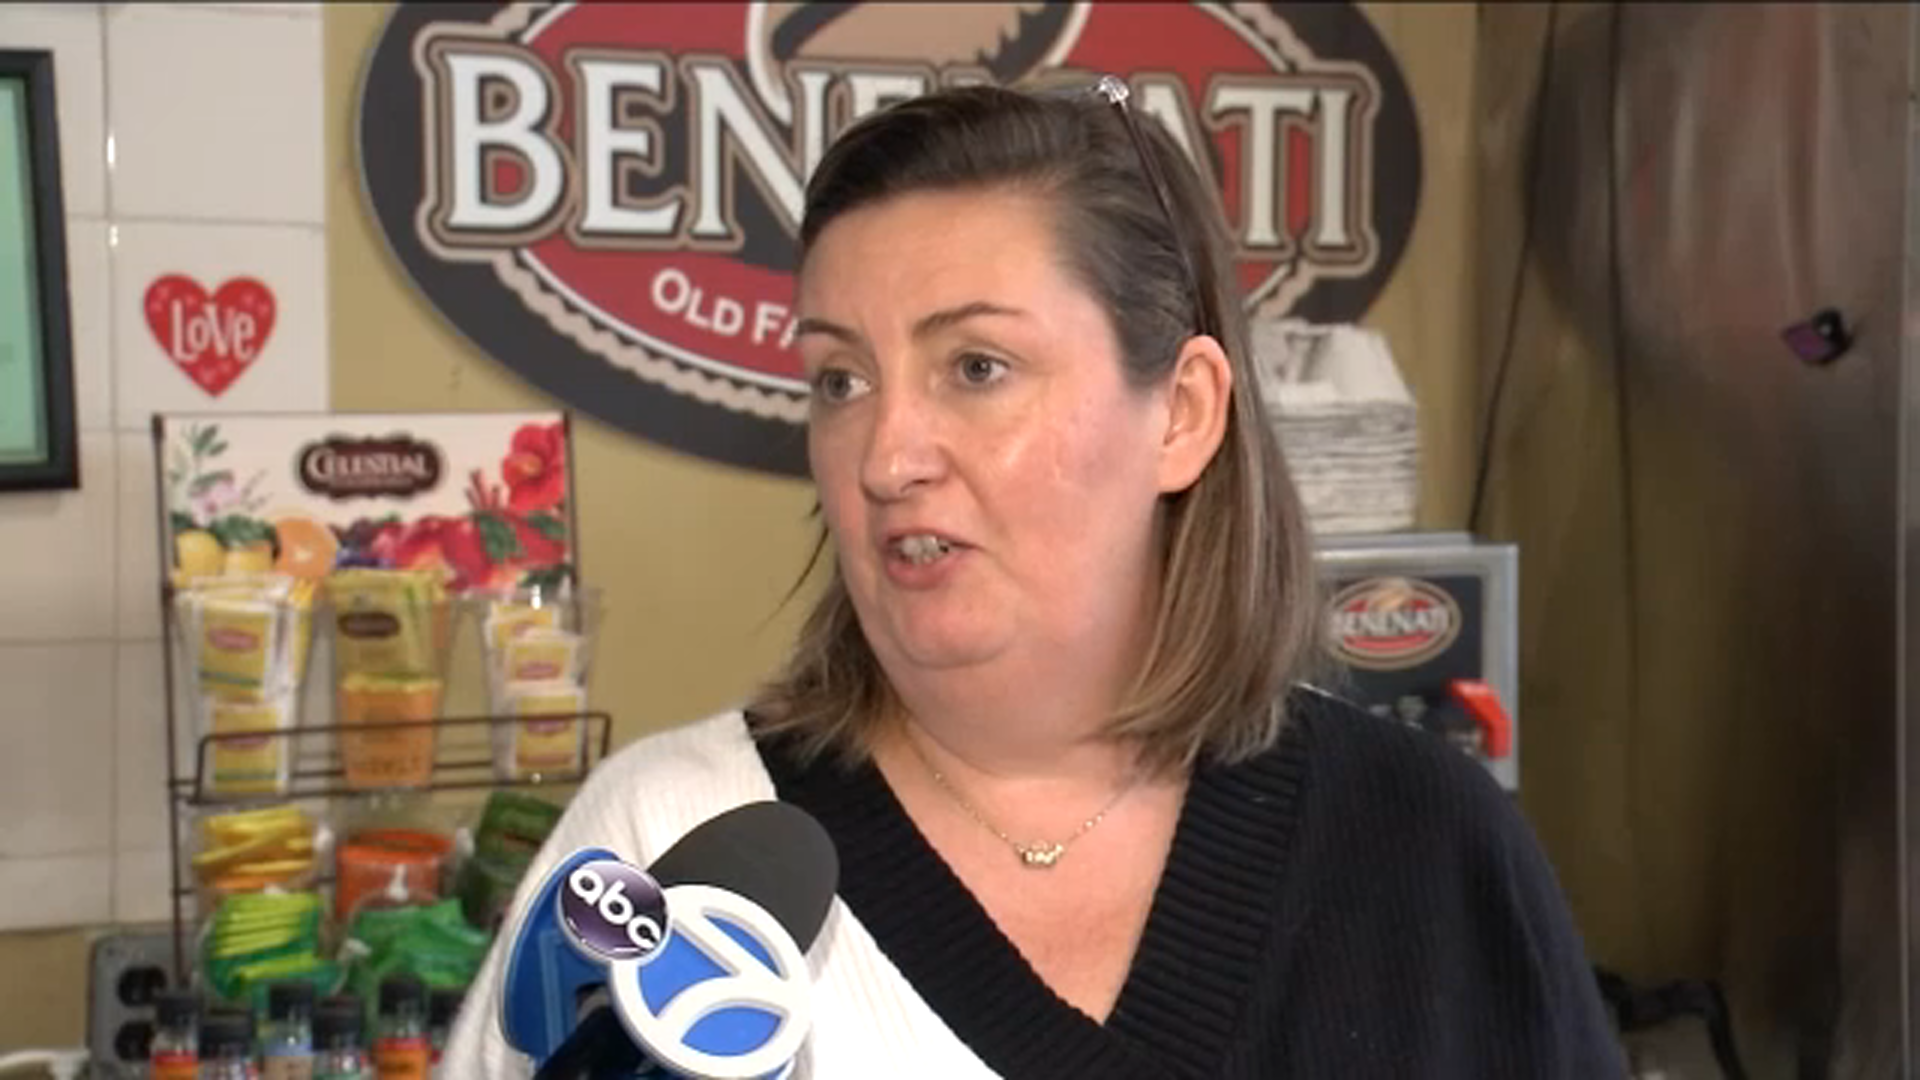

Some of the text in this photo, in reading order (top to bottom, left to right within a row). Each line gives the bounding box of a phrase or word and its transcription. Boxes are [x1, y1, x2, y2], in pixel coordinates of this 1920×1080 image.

[446, 53, 1353, 247] BENTI
[651, 268, 744, 336] OLD
[569, 868, 661, 950] abc
